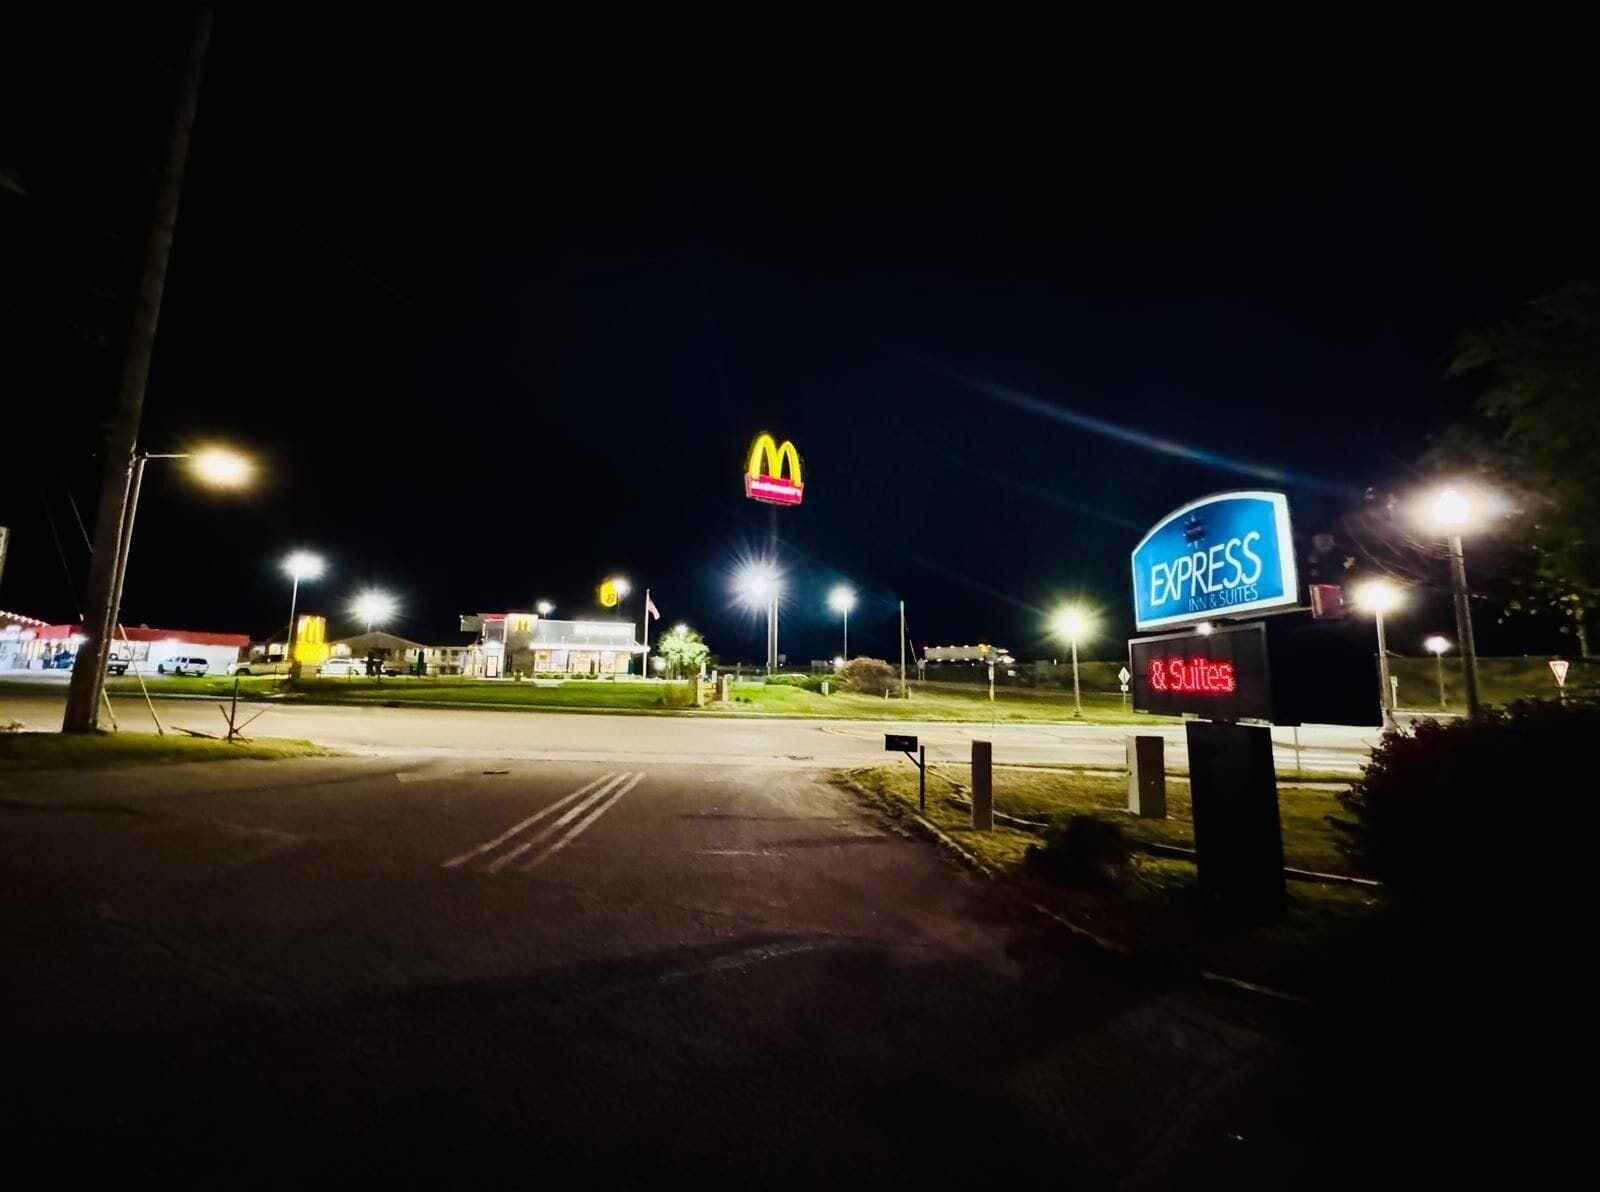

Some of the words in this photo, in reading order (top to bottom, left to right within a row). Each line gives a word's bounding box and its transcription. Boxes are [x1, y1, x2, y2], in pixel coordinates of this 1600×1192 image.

[1151, 532, 1261, 606] EXPRESS
[1188, 596, 1207, 612] INN
[1209, 594, 1217, 608] &
[1219, 583, 1258, 606] SUITES
[1152, 661, 1167, 690] &
[1170, 659, 1233, 692] Suites
